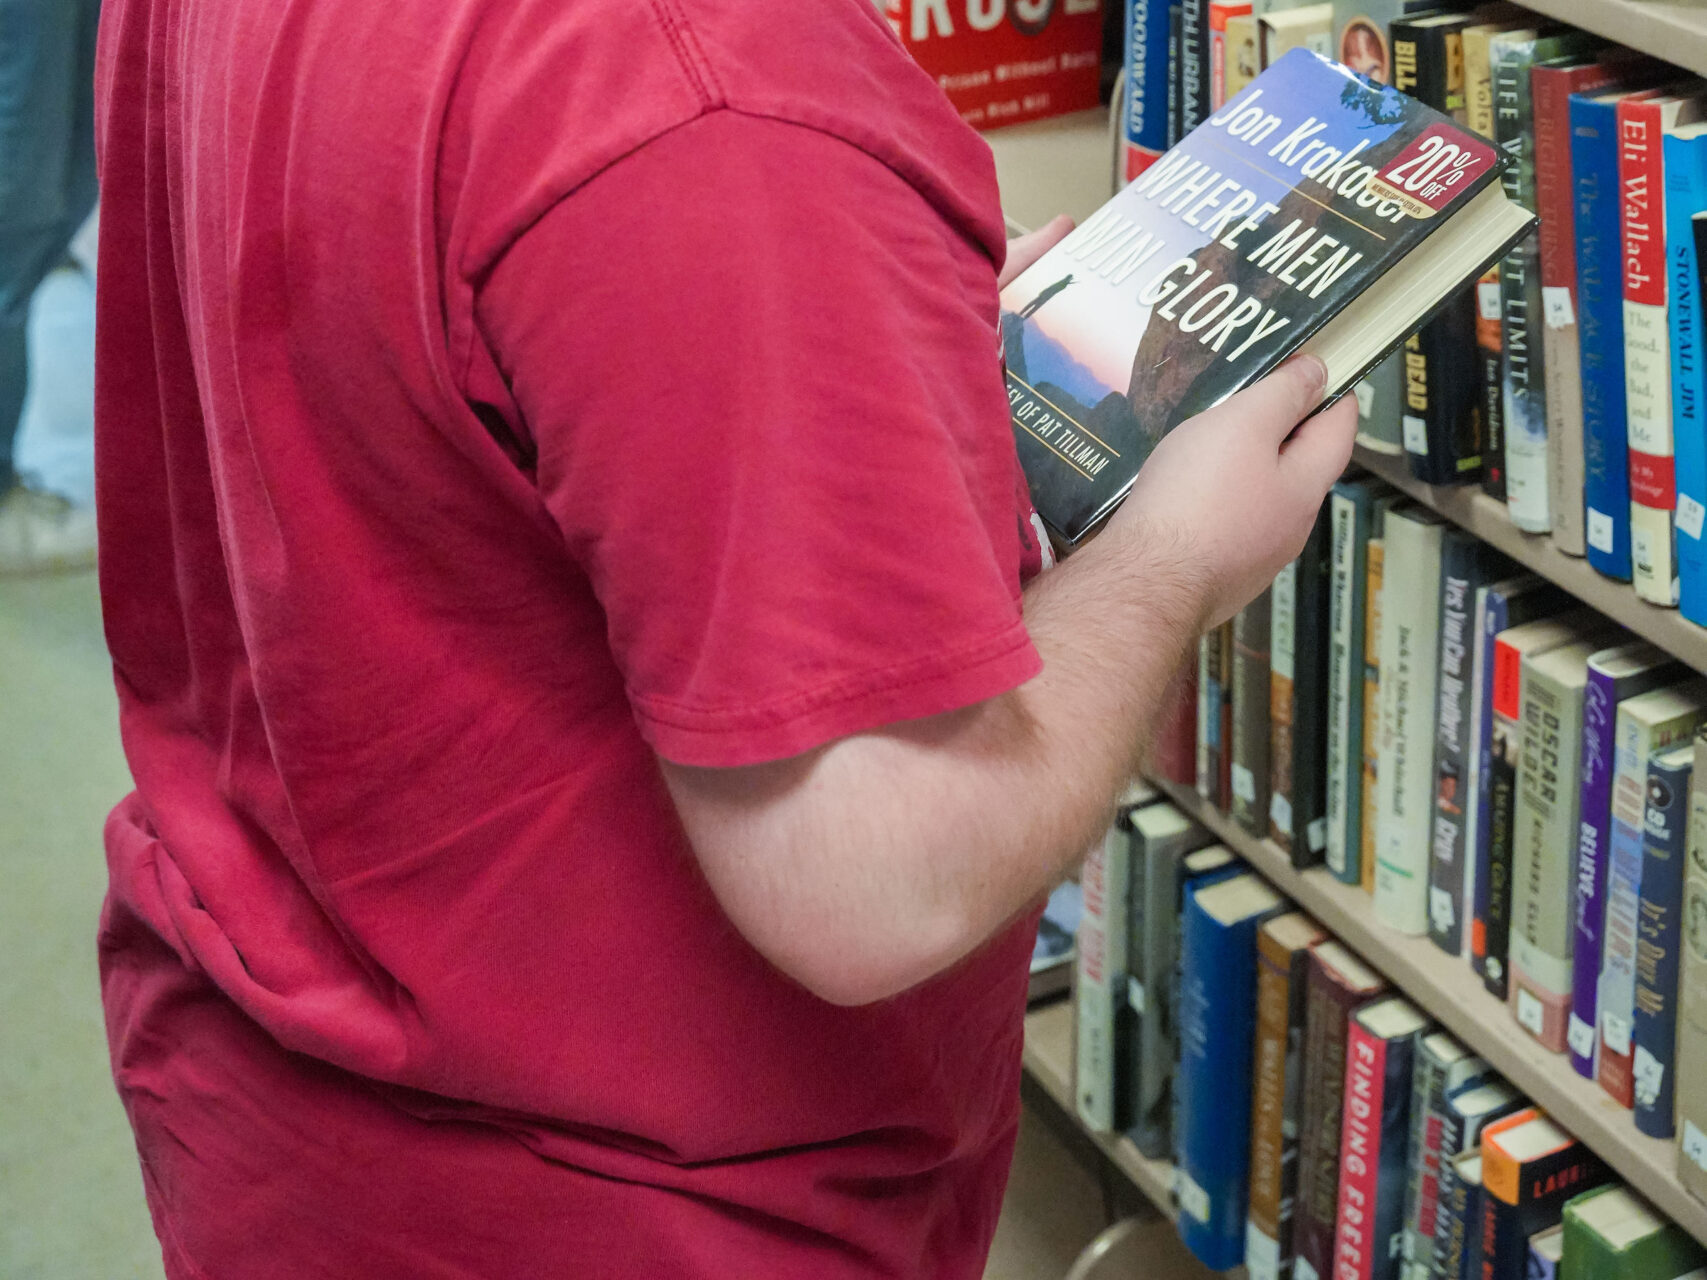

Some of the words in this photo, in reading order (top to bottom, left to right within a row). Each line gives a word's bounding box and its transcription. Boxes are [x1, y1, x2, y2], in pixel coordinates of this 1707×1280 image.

[1182, 38, 1201, 132] URBAN
[1393, 40, 1418, 95] BILL
[1497, 56, 1520, 121] LIFE
[1211, 88, 1282, 147] Jon
[1623, 119, 1647, 161] Eli
[1385, 135, 1480, 192] 20%
[1420, 181, 1448, 200] OFF
[1137, 151, 1279, 250] WHERE
[1248, 221, 1364, 301] MEN
[1500, 136, 1526, 287] WITUT
[1623, 171, 1651, 290] Wallach
[1066, 210, 1167, 288] WIN
[1139, 257, 1292, 363] GLORY
[1675, 246, 1697, 376] STONEWALL
[1404, 353, 1428, 411] DEAD
[1504, 299, 1530, 398] LIMITS
[1016, 400, 1041, 421] OF
[1032, 412, 1063, 439] PAT
[1053, 428, 1110, 476] TILLMAN
[1631, 424, 1652, 444] Me
[1680, 383, 1696, 420] JIM
[1523, 701, 1540, 792] WILDE
[1541, 710, 1561, 803] OSCAR
[1578, 820, 1598, 898] BELIEVE
[1345, 1040, 1375, 1176] FINDING
